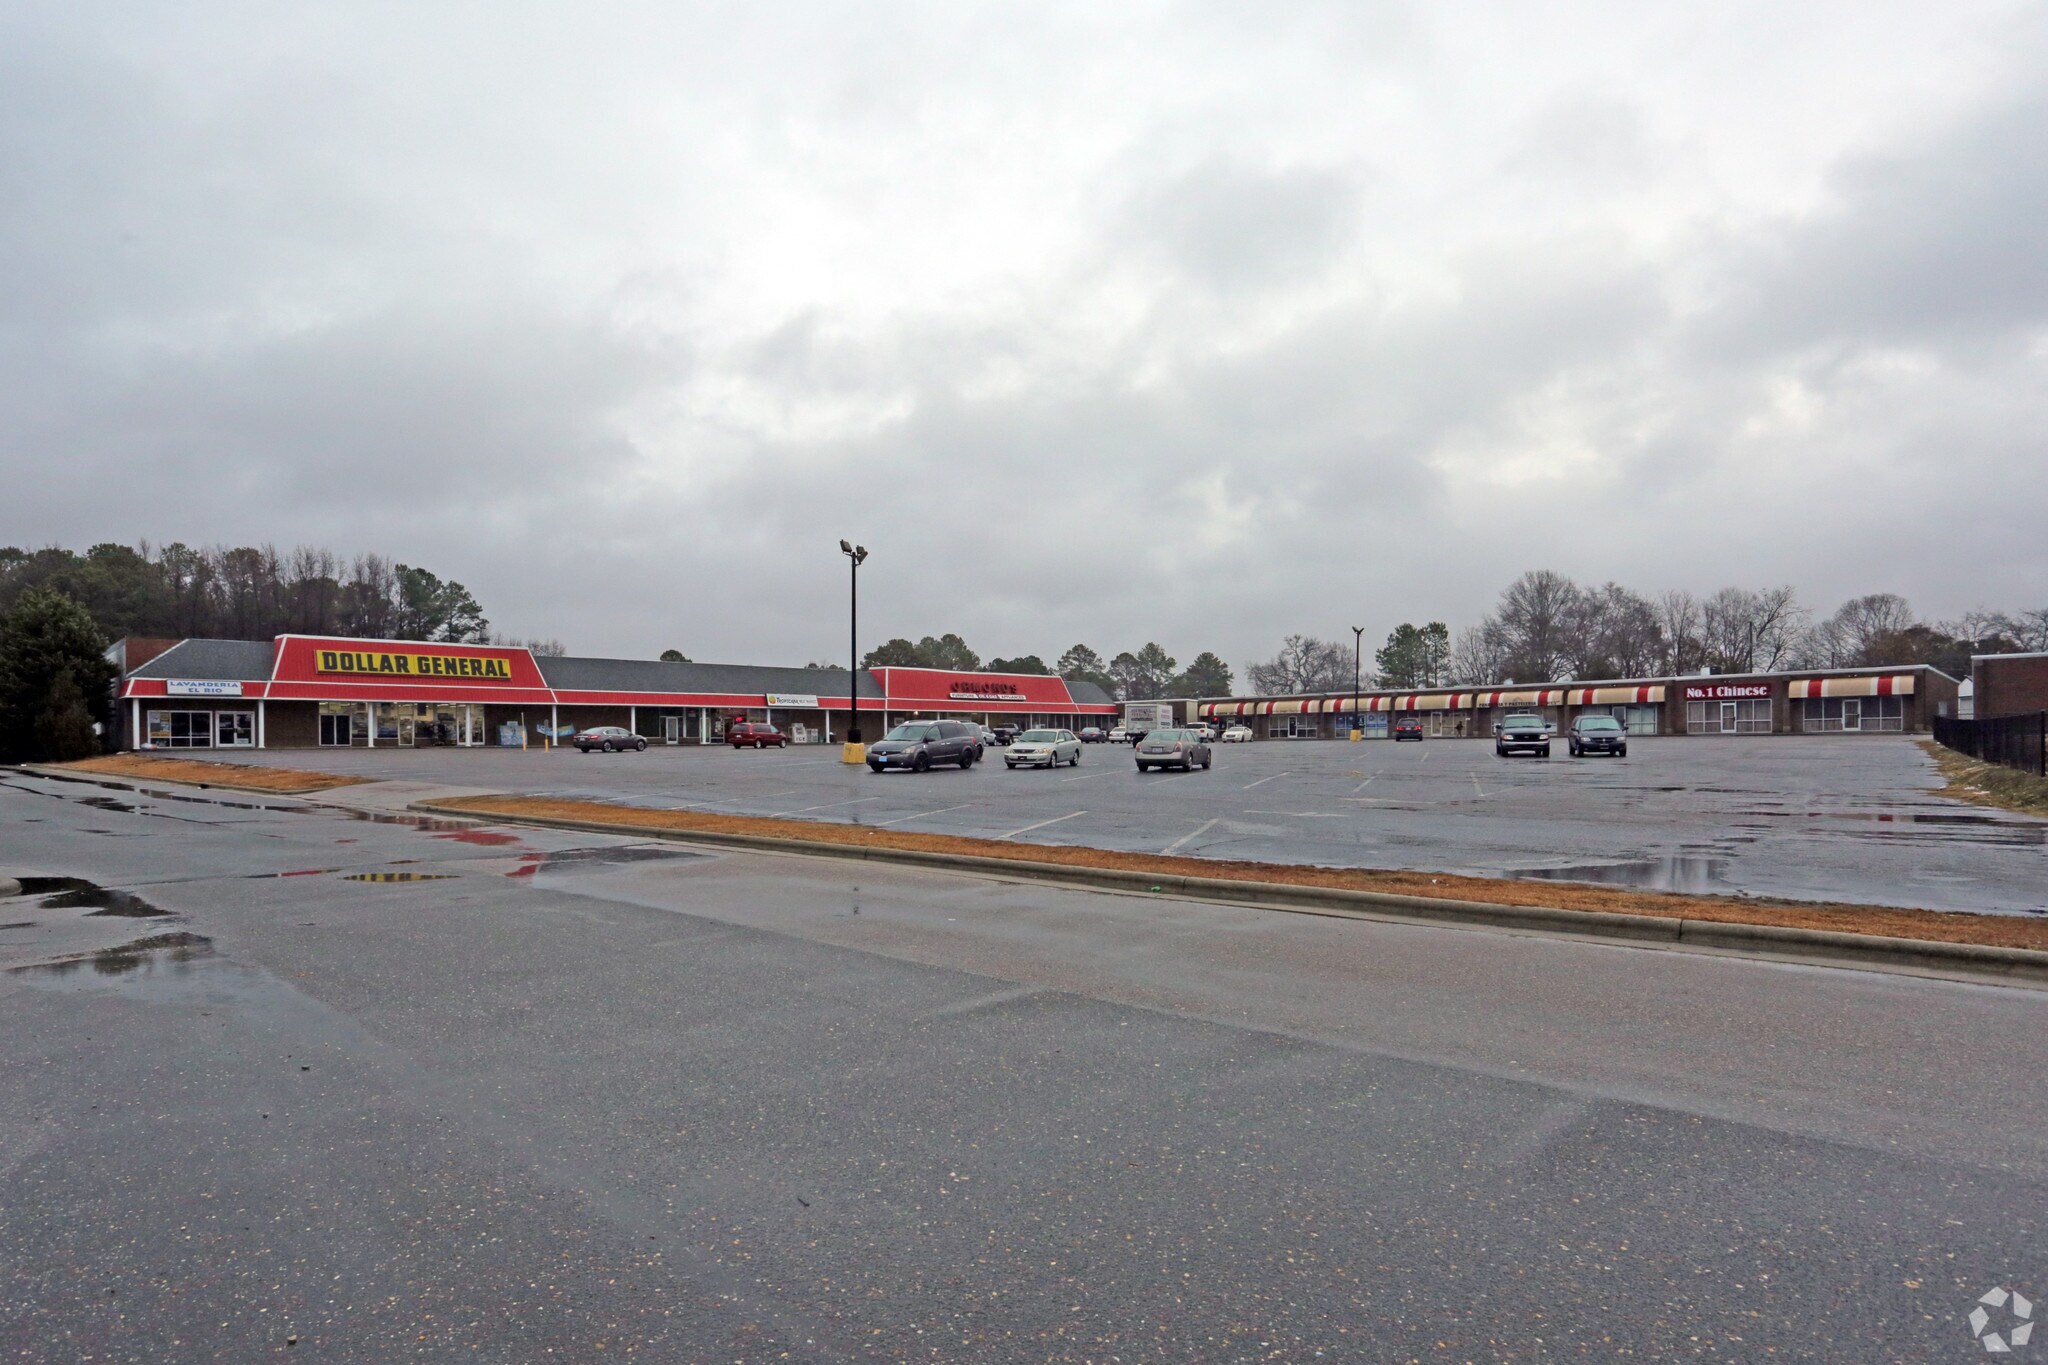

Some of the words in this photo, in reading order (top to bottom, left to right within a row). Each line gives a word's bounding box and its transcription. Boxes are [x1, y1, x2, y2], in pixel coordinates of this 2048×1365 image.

[322, 651, 410, 673] DOLLAR
[417, 656, 508, 677] GENERAL
[1716, 686, 1768, 697] Chinese
